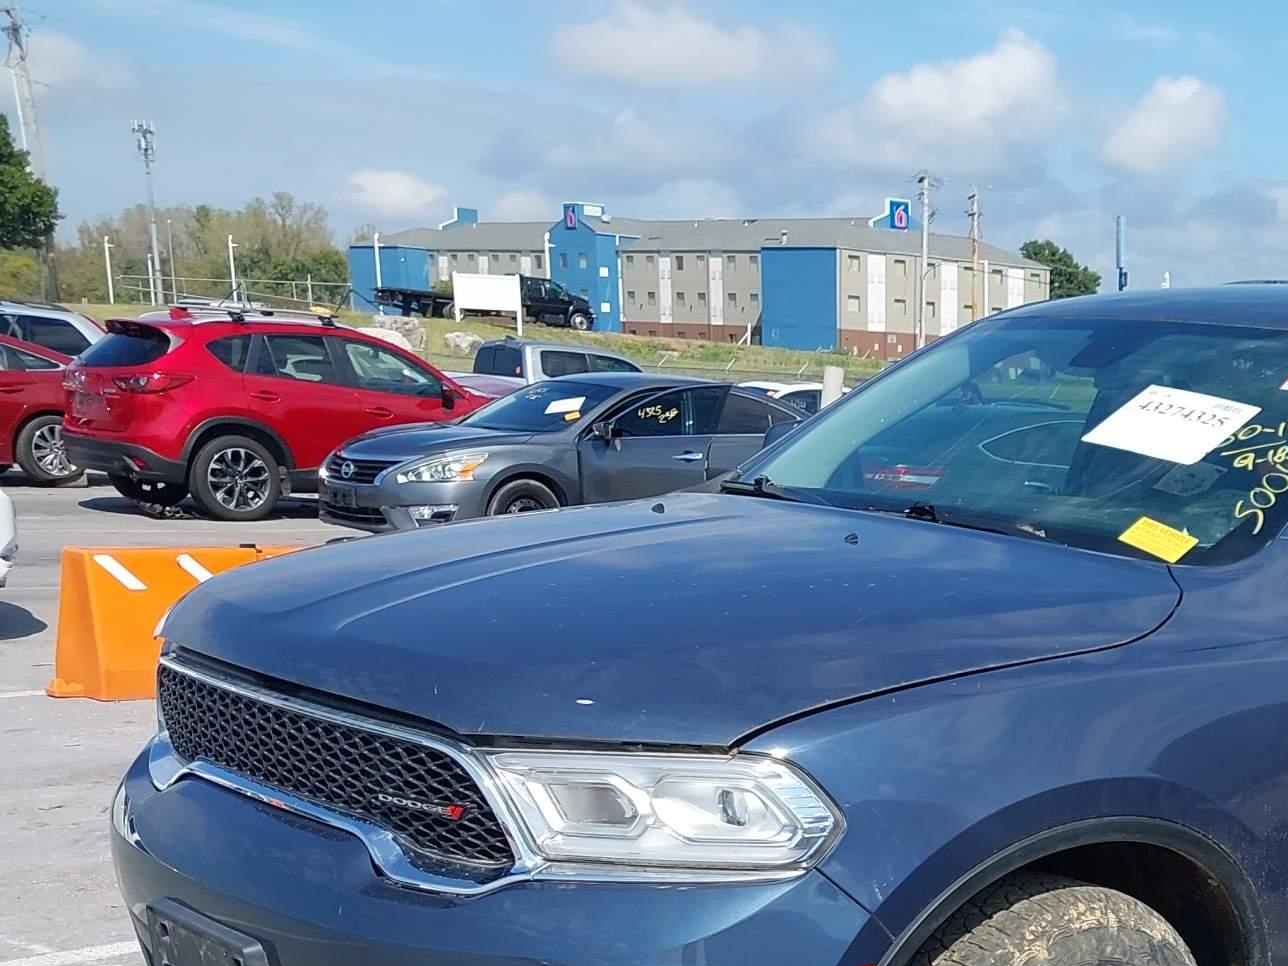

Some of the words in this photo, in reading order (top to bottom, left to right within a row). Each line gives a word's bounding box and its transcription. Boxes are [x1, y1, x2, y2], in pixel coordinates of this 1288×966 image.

[895, 205, 907, 227] 6
[1138, 400, 1232, 428] 43274325
[378, 794, 452, 815] DODGE
